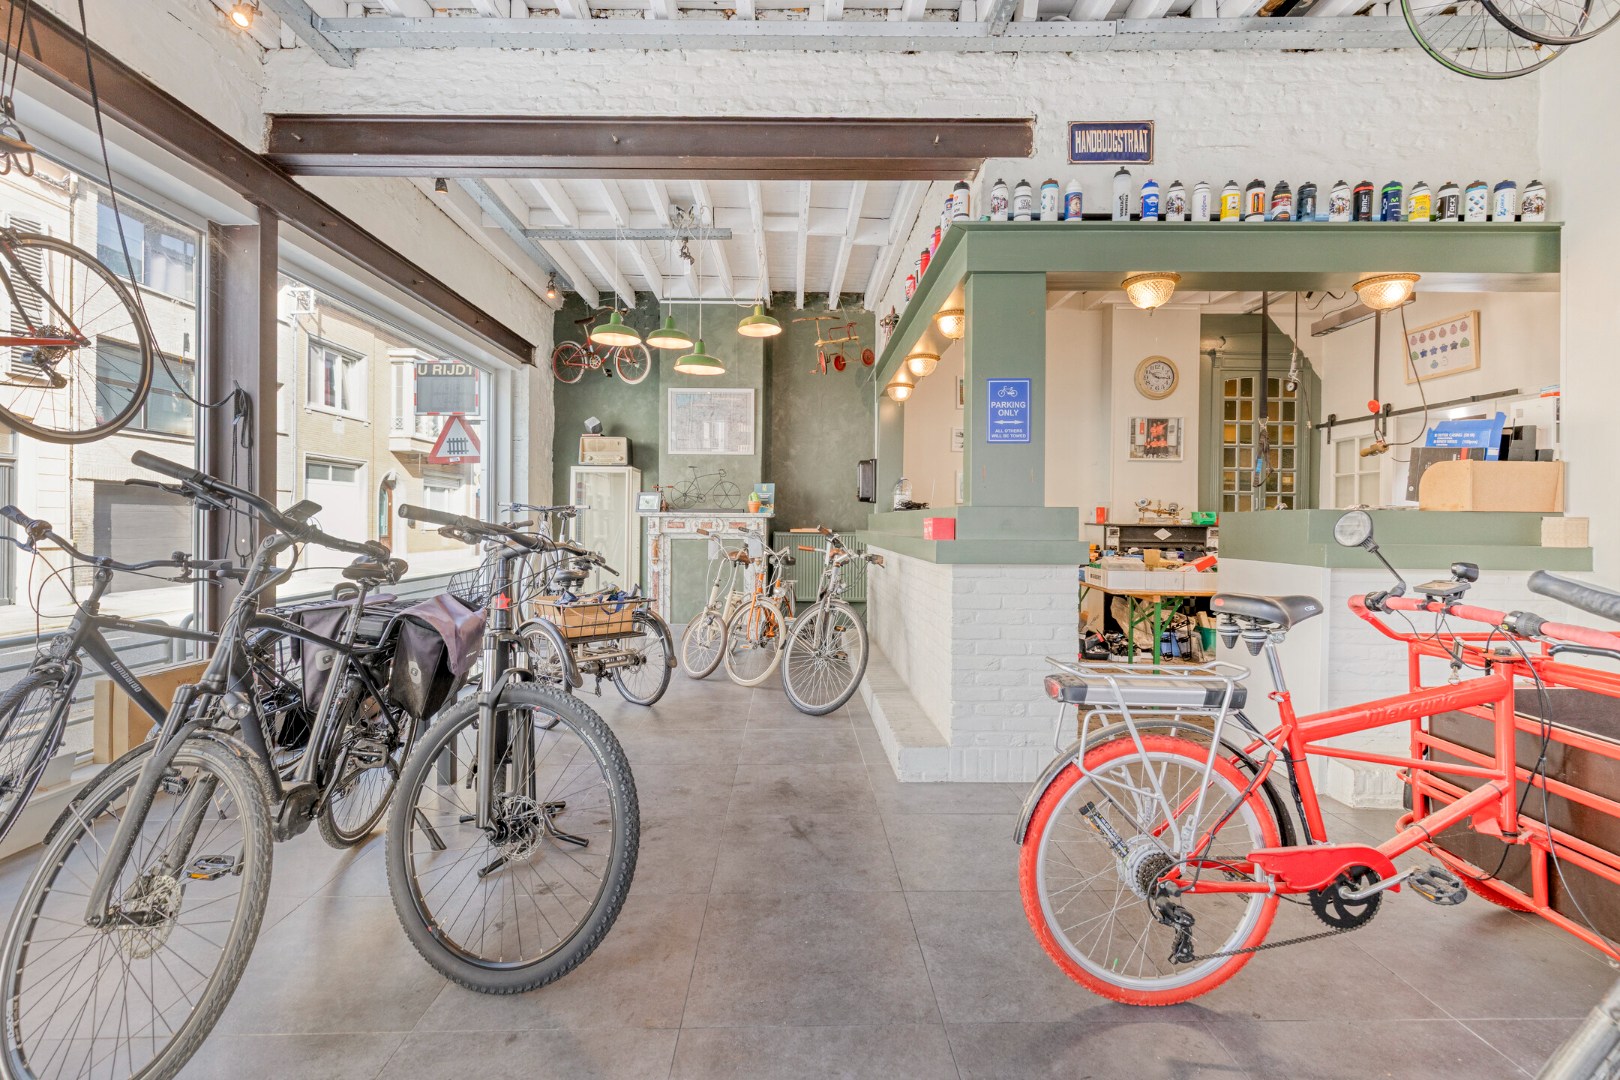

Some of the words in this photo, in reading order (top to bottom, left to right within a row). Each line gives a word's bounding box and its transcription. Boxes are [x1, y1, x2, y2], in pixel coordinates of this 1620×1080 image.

[1075, 129, 1149, 154] HANDBOOGSTRAAT
[1447, 196, 1456, 218] Tacx
[418, 364, 427, 375] U
[432, 364, 473, 376] RIJDT
[991, 401, 1026, 409] PARKING
[997, 409, 1019, 417] ONLY
